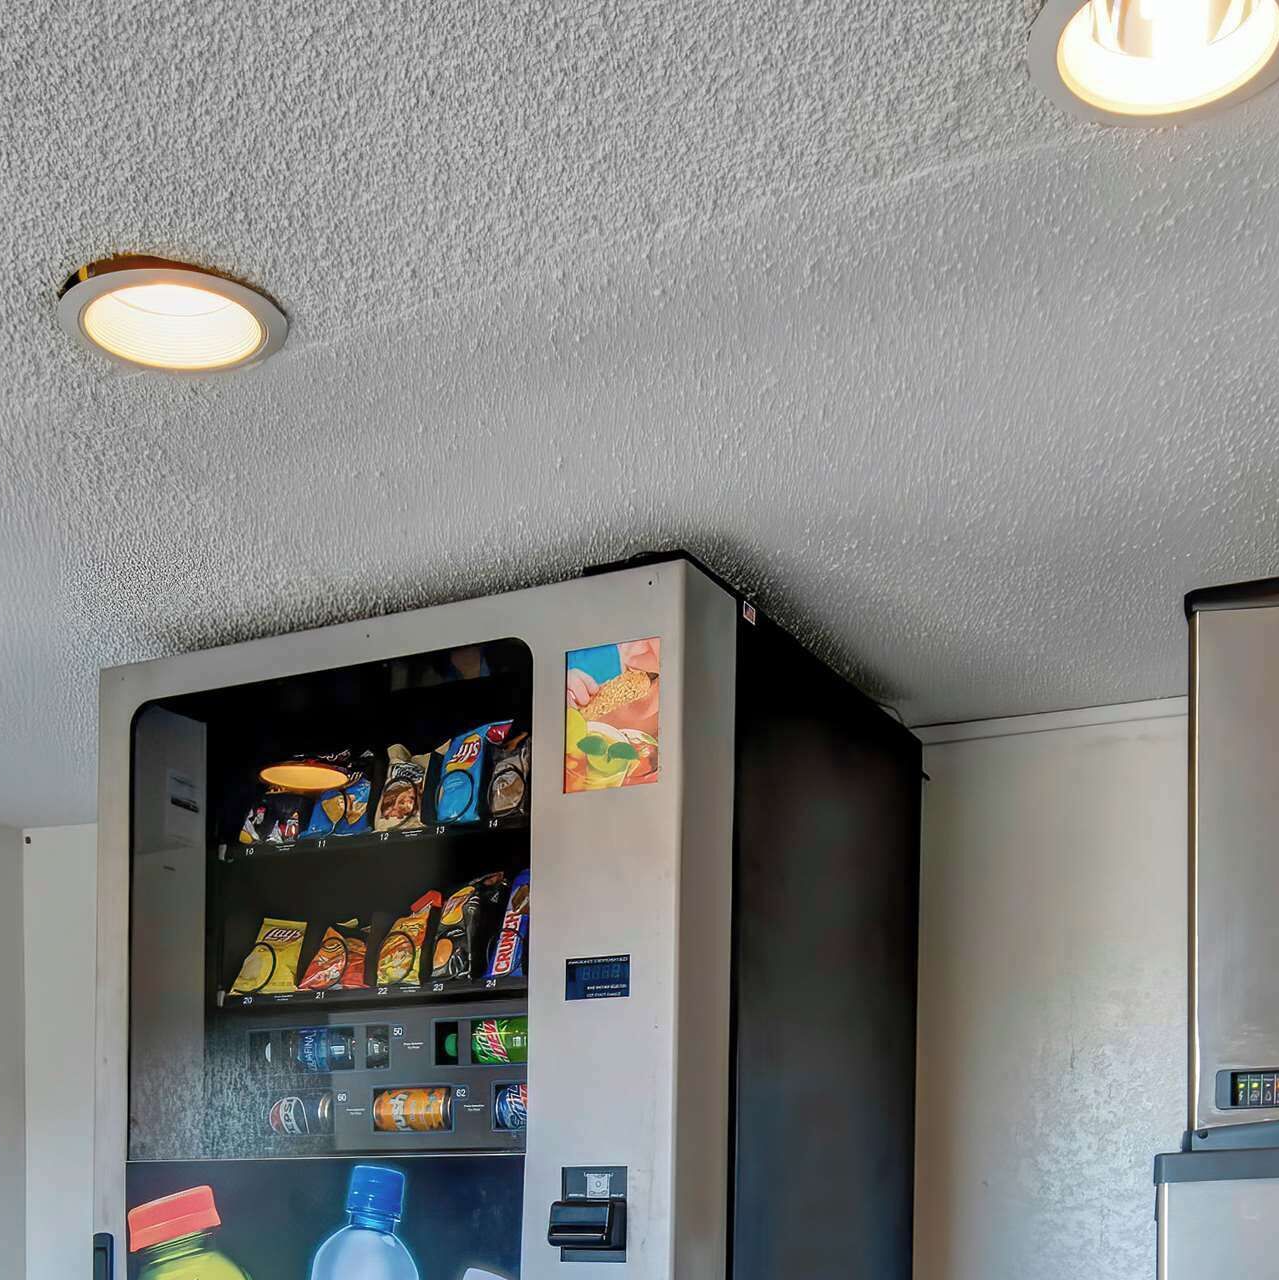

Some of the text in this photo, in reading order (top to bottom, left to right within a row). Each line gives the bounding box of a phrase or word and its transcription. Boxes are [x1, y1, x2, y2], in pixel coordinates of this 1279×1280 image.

[488, 819, 498, 828] 14
[436, 826, 445, 834] 13
[318, 840, 327, 848] 11
[245, 848, 255, 856] 10
[495, 911, 521, 974] CRUNCH
[433, 983, 444, 992] 23
[486, 979, 496, 988] 24
[377, 987, 388, 995] 22
[243, 997, 253, 1005] 20
[393, 1027, 403, 1036] 50
[337, 1093, 347, 1102] 60
